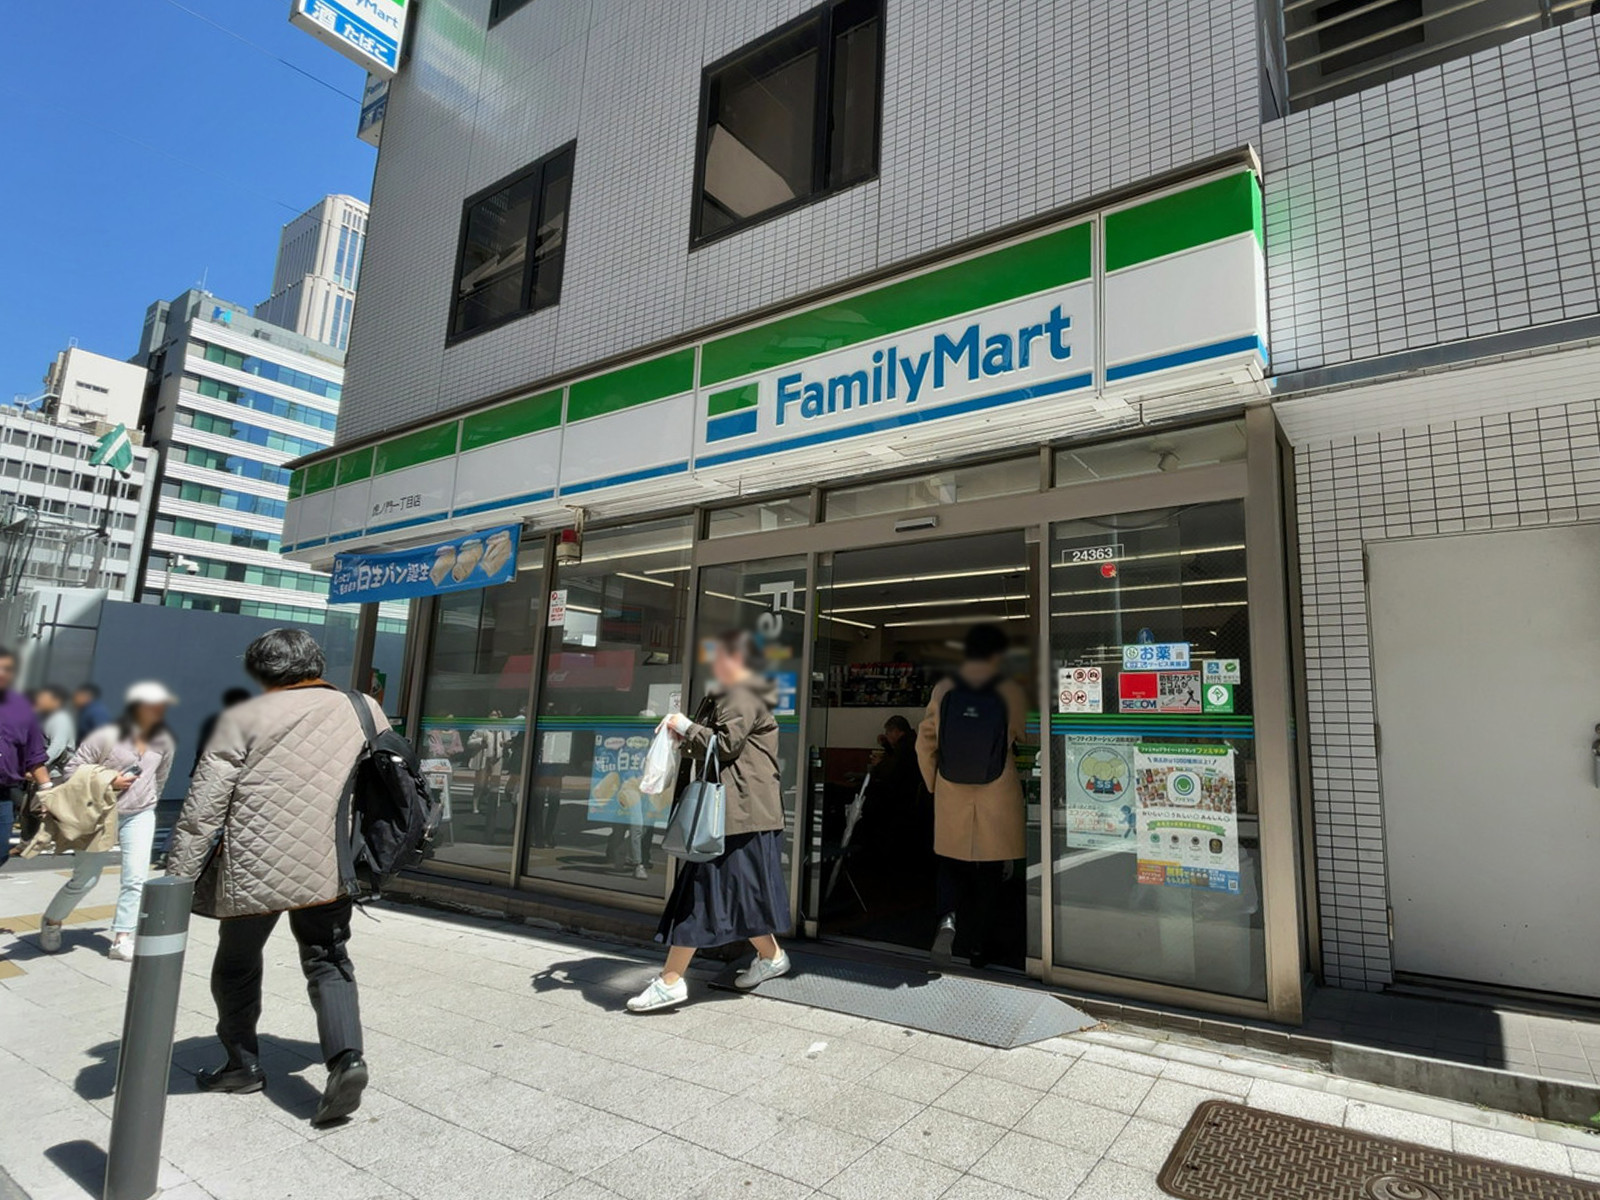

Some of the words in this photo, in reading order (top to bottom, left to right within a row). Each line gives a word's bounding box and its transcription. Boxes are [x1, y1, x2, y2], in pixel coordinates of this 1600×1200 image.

[343, 23, 389, 62] たばこ
[775, 304, 1071, 426] FamilyMart
[372, 494, 422, 517] 虎ノ門一丁目店
[1072, 547, 1113, 562] 24363
[357, 560, 430, 592] 白生パン誕生
[1140, 646, 1171, 661] お薬
[1160, 681, 1188, 689] セコムが
[1122, 700, 1157, 709] SECOM
